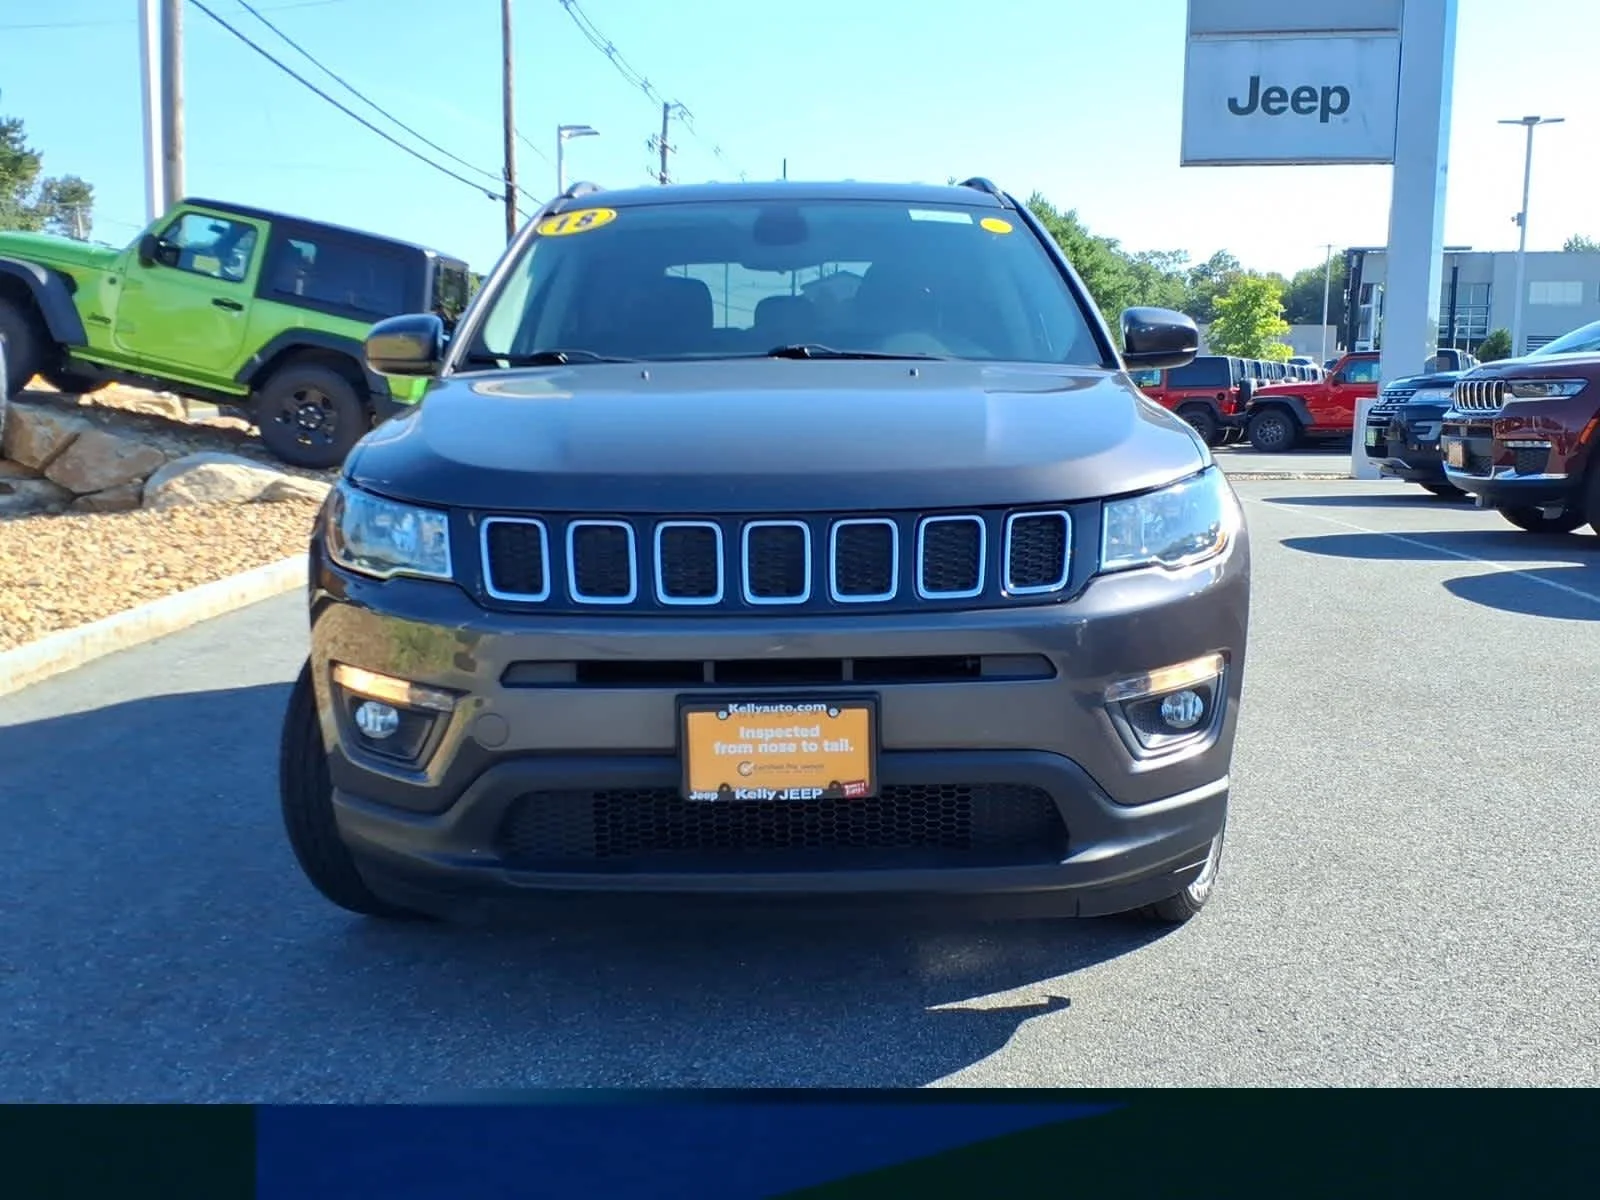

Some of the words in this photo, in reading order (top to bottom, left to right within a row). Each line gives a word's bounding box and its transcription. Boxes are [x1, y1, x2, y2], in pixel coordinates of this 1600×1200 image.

[1227, 75, 1350, 123] Jeep
[554, 211, 599, 232] 18
[728, 702, 827, 714] Kellyauto.com
[739, 725, 820, 740] Inspected
[713, 741, 753, 755] from
[758, 742, 798, 753] nose
[801, 741, 818, 753] to
[823, 738, 855, 753] tail.
[689, 790, 718, 802] Jeep
[735, 787, 778, 801] Kelly
[780, 787, 823, 800] JEEP
